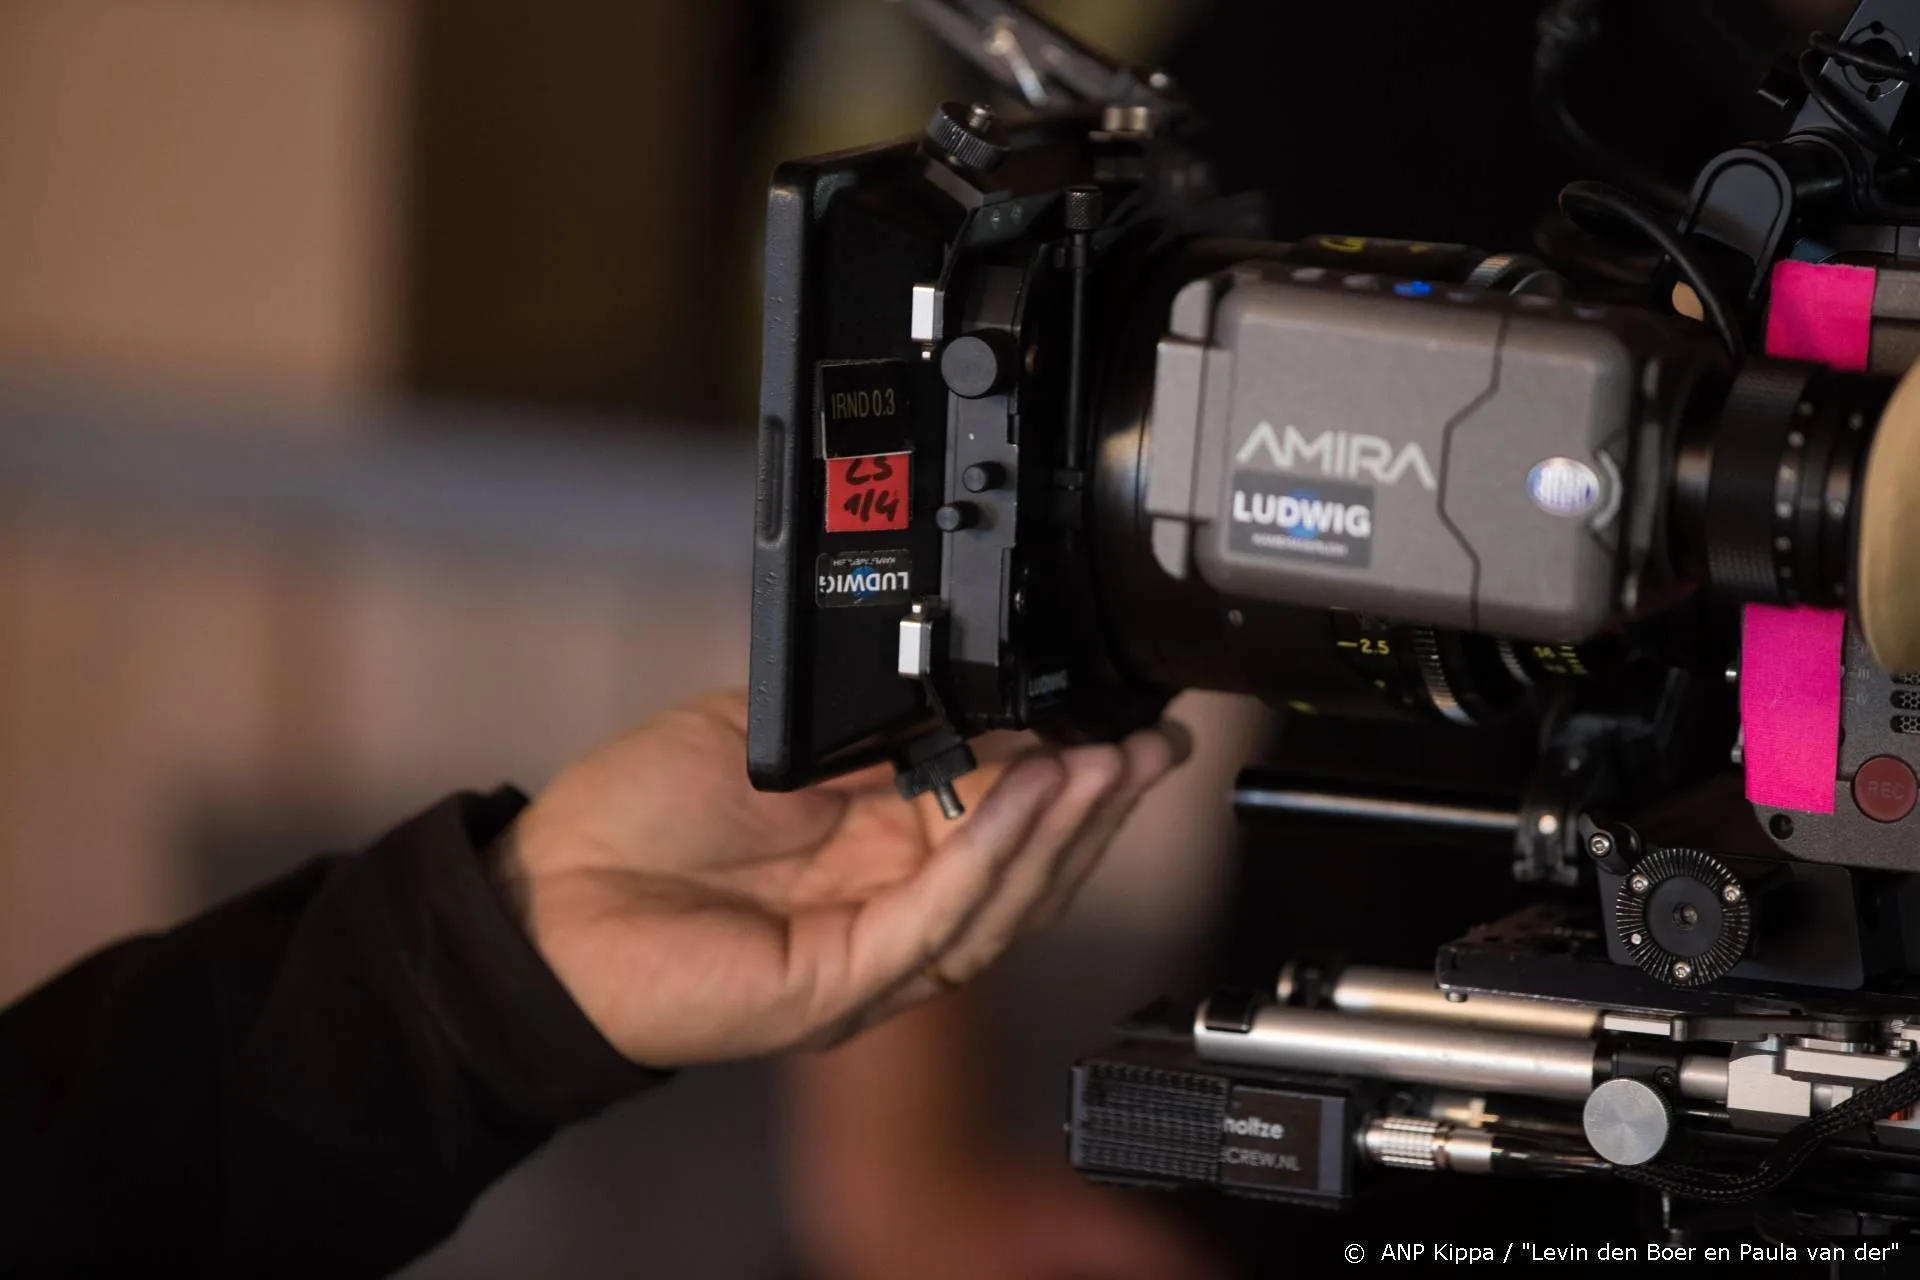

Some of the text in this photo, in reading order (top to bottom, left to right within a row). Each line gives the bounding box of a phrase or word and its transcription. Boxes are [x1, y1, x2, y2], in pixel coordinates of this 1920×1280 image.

[831, 387, 896, 420] IRND 0.3
[1236, 421, 1437, 491] AMIRA
[1233, 491, 1371, 539] LUDWIG
[818, 571, 909, 594] LUDWIG
[1359, 637, 1390, 656] 2.5
[1867, 780, 1906, 800] REC
